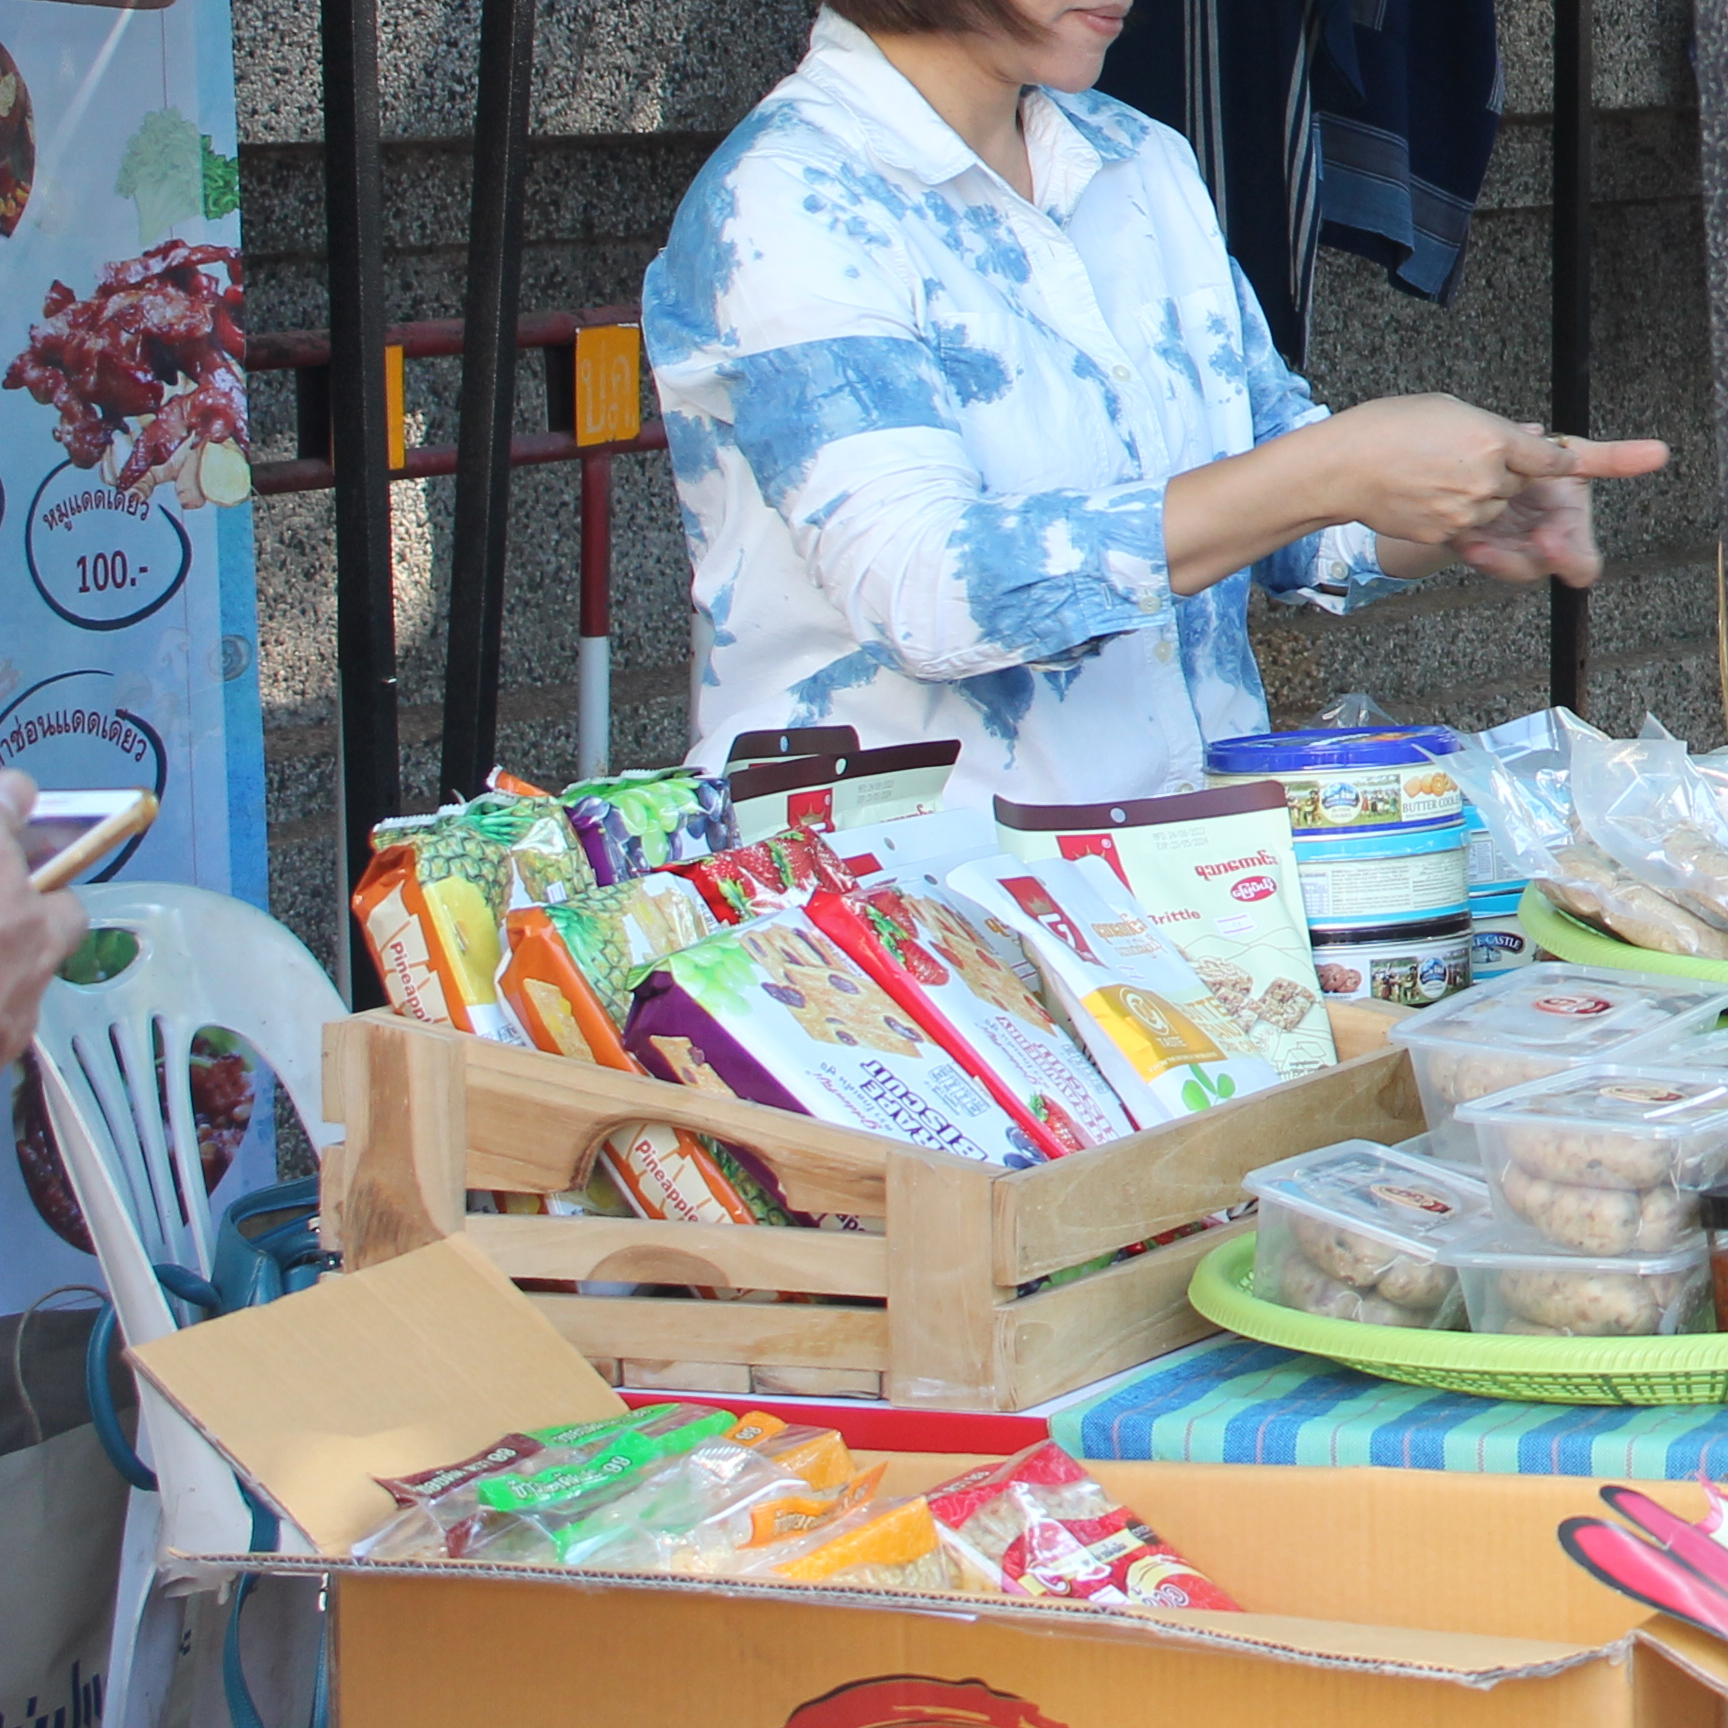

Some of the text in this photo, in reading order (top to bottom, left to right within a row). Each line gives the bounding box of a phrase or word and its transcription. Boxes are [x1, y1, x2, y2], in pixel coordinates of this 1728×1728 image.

[43, 489, 150, 532] หมูแดดเดยว
[77, 550, 148, 593] 100.-
[1484, 933, 1522, 951] CASTLE
[859, 1078, 952, 1154] RAPE
[634, 1138, 699, 1223] Pineapple
